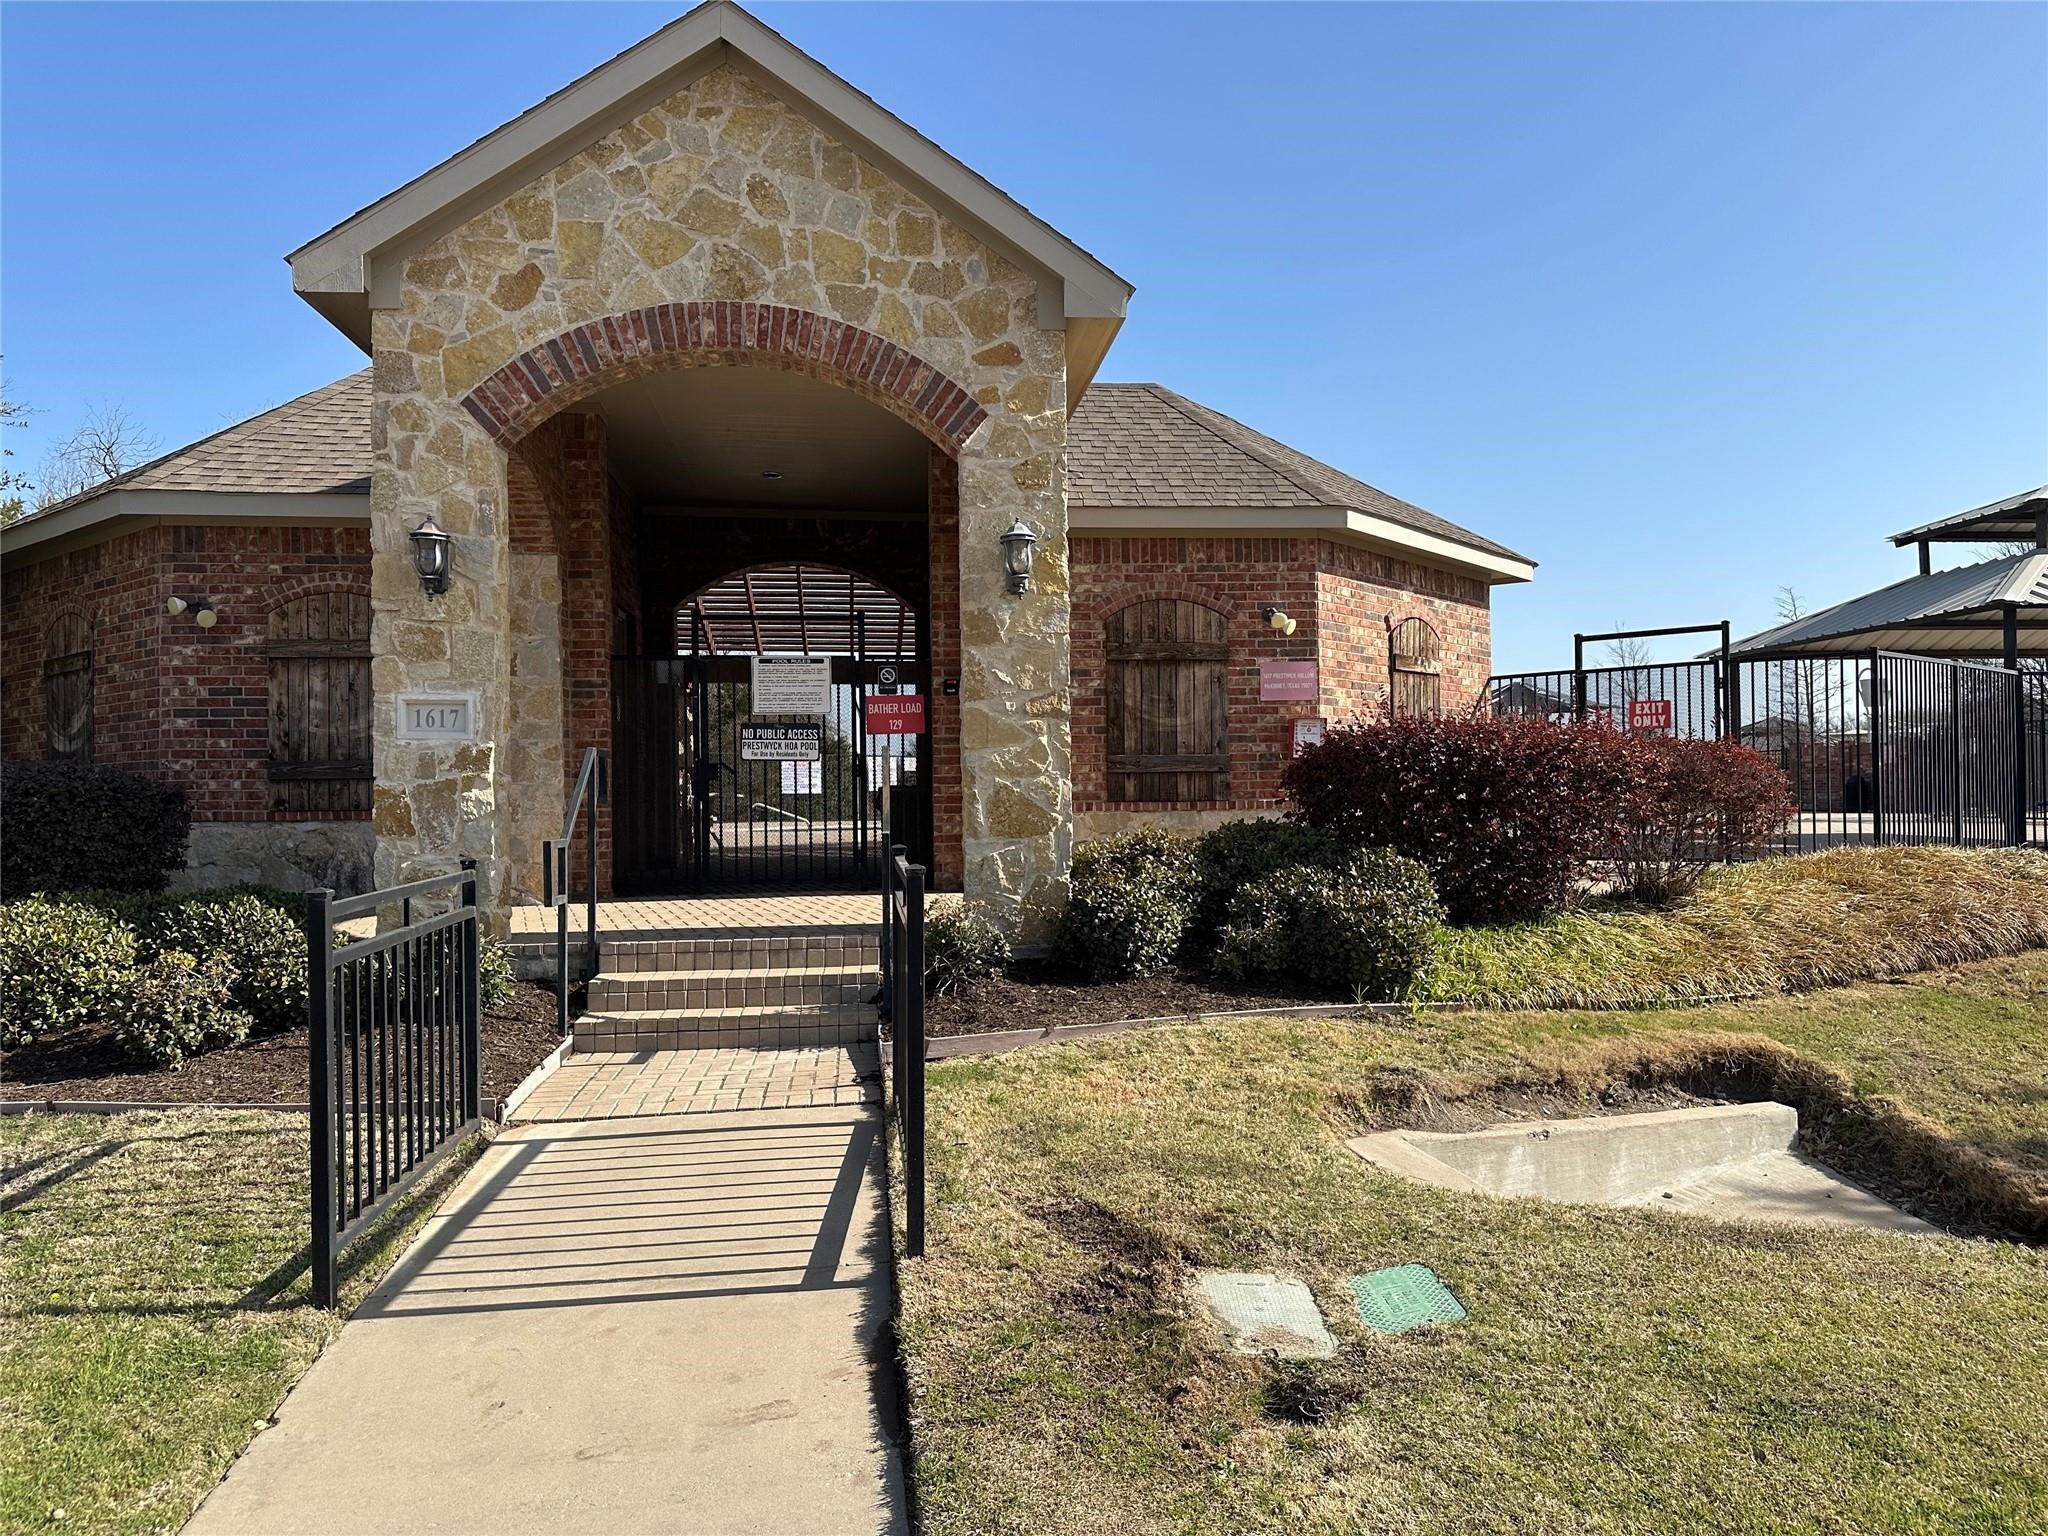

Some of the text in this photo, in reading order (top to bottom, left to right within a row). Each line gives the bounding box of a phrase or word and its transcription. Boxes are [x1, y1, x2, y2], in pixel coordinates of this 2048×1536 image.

[868, 702, 922, 714] BATHER LOAD
[1635, 702, 1664, 714] EXIT
[415, 708, 459, 728] 1617
[1633, 715, 1666, 727] ONLY
[889, 719, 903, 730] 129
[742, 728, 818, 740] NO PUBLIC ACCESS
[742, 741, 817, 751] PRESTWYCK HOA POOL
